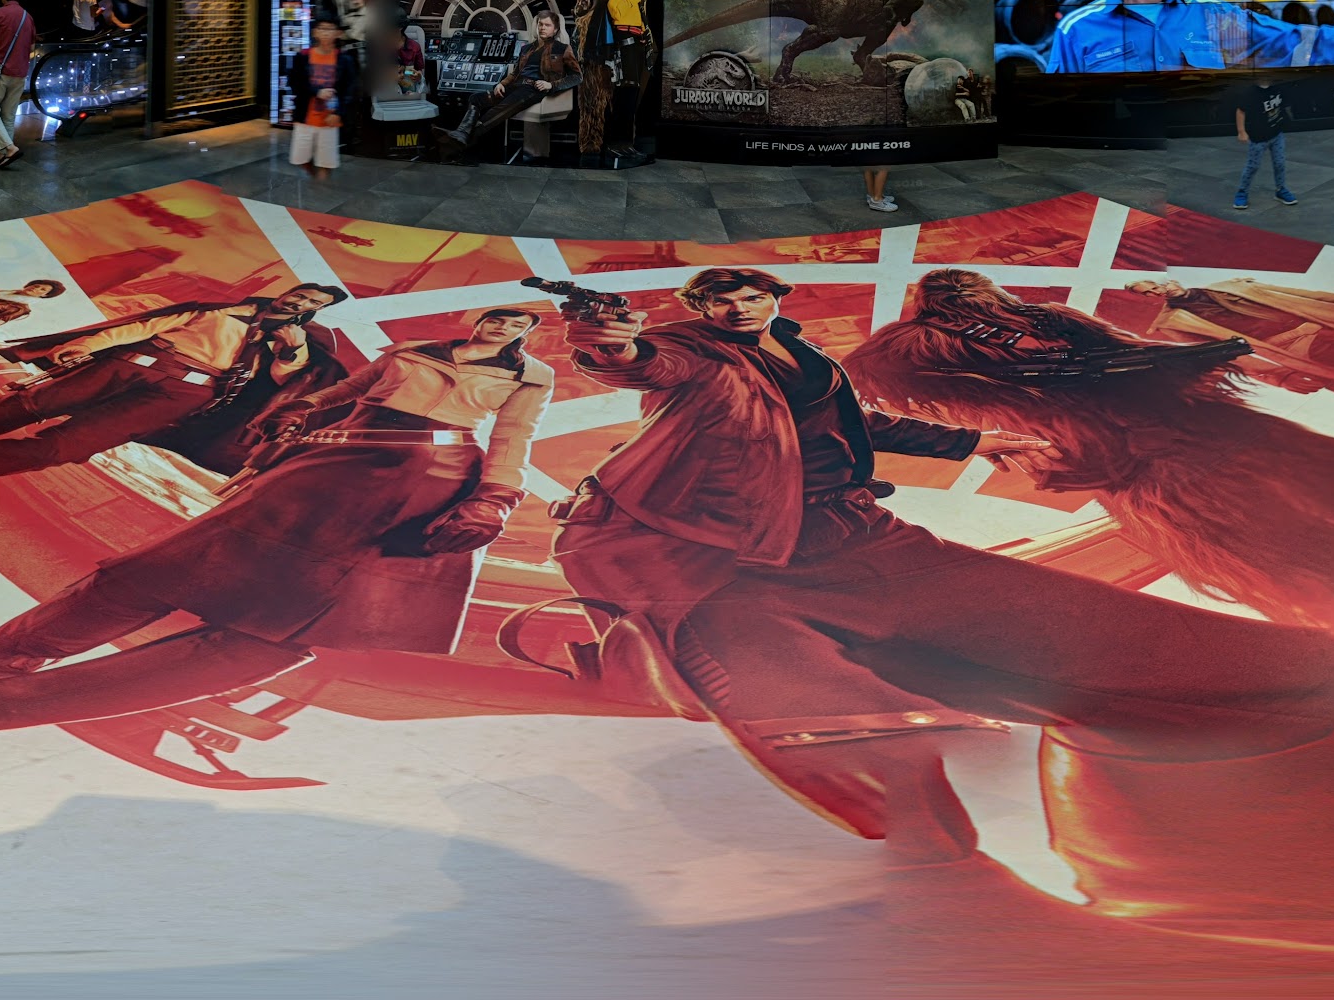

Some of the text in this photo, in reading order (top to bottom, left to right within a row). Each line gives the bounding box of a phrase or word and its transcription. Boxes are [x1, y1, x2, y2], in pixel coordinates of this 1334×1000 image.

[674, 88, 766, 107] JURASSIC WORLD
[396, 133, 419, 147] MAY
[745, 141, 769, 150] LIFE
[771, 142, 805, 151] FINDS
[850, 142, 881, 151] JUNE
[882, 141, 911, 149] 2018
